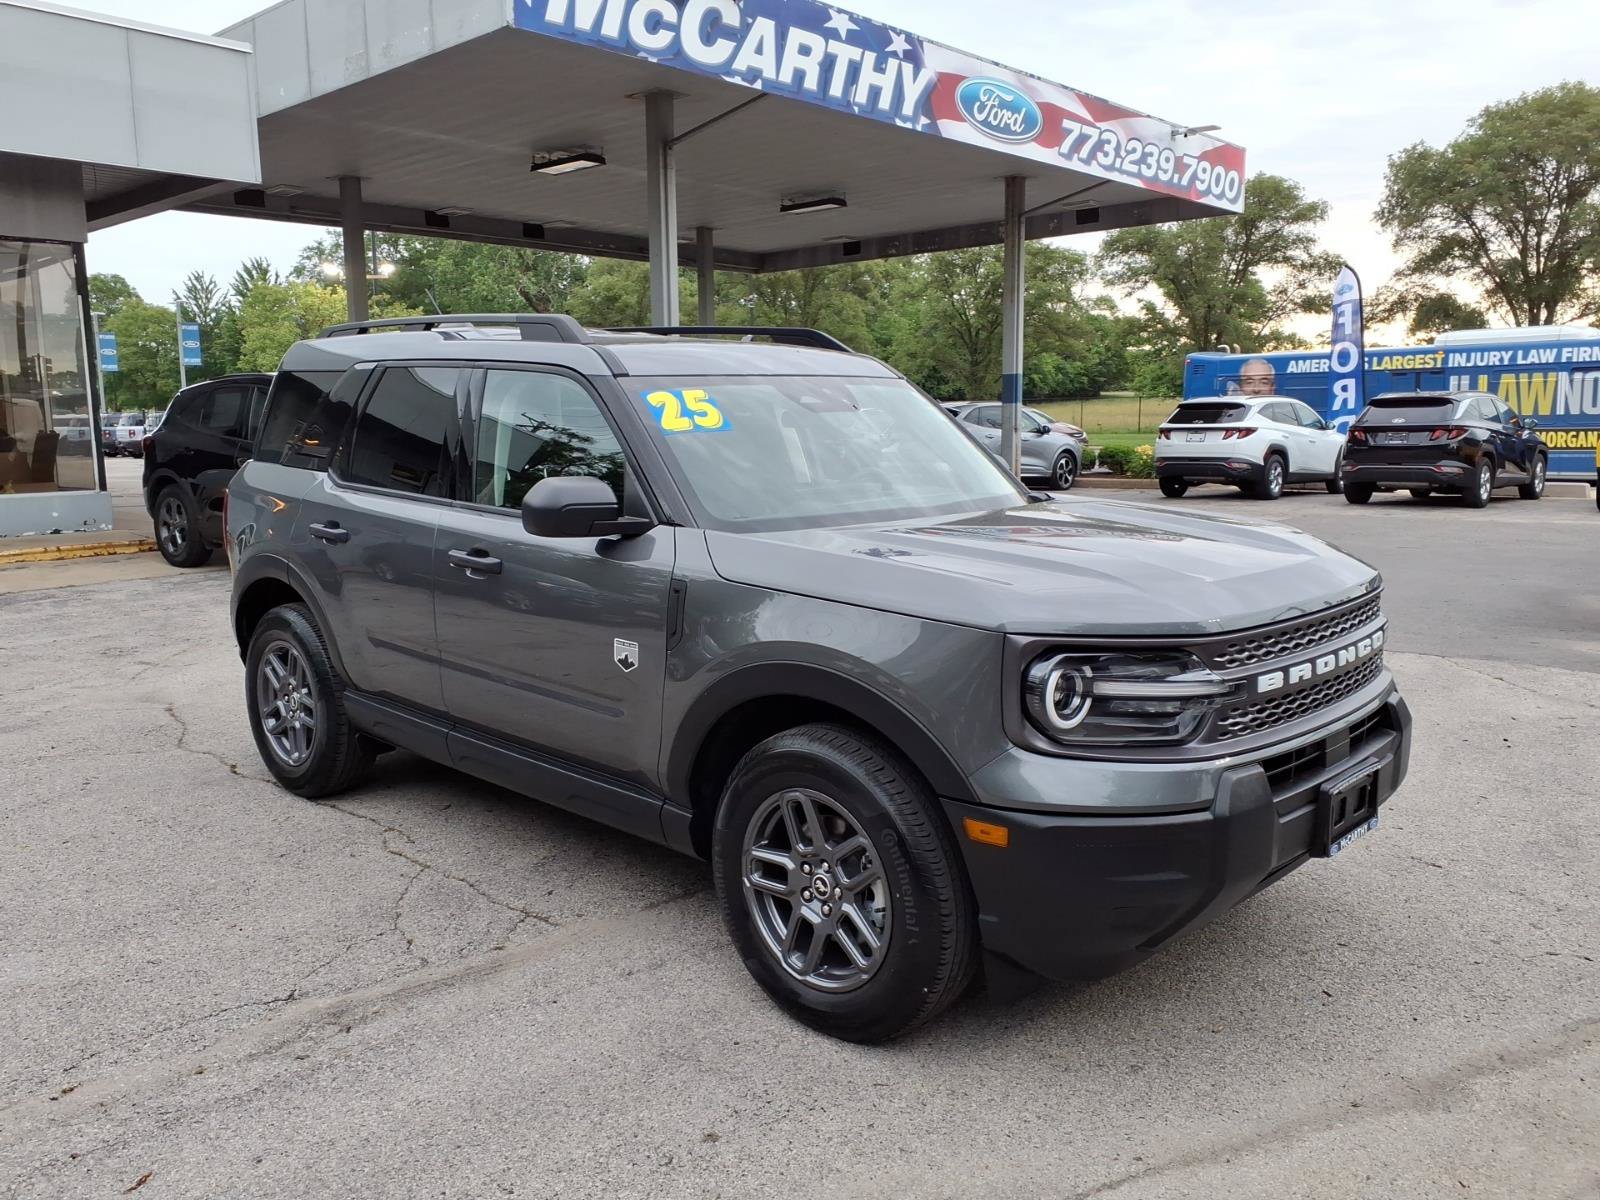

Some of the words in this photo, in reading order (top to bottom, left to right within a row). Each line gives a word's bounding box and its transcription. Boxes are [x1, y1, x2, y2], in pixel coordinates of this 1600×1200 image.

[973, 85, 1027, 134] Ford
[1058, 118, 1241, 201] 773.239.7900
[1372, 353, 1445, 370] LARGEST
[1448, 350, 1513, 368] INJURY
[1517, 348, 1558, 365] LAW
[646, 389, 724, 431] 25
[1257, 630, 1384, 694] BRONCO
